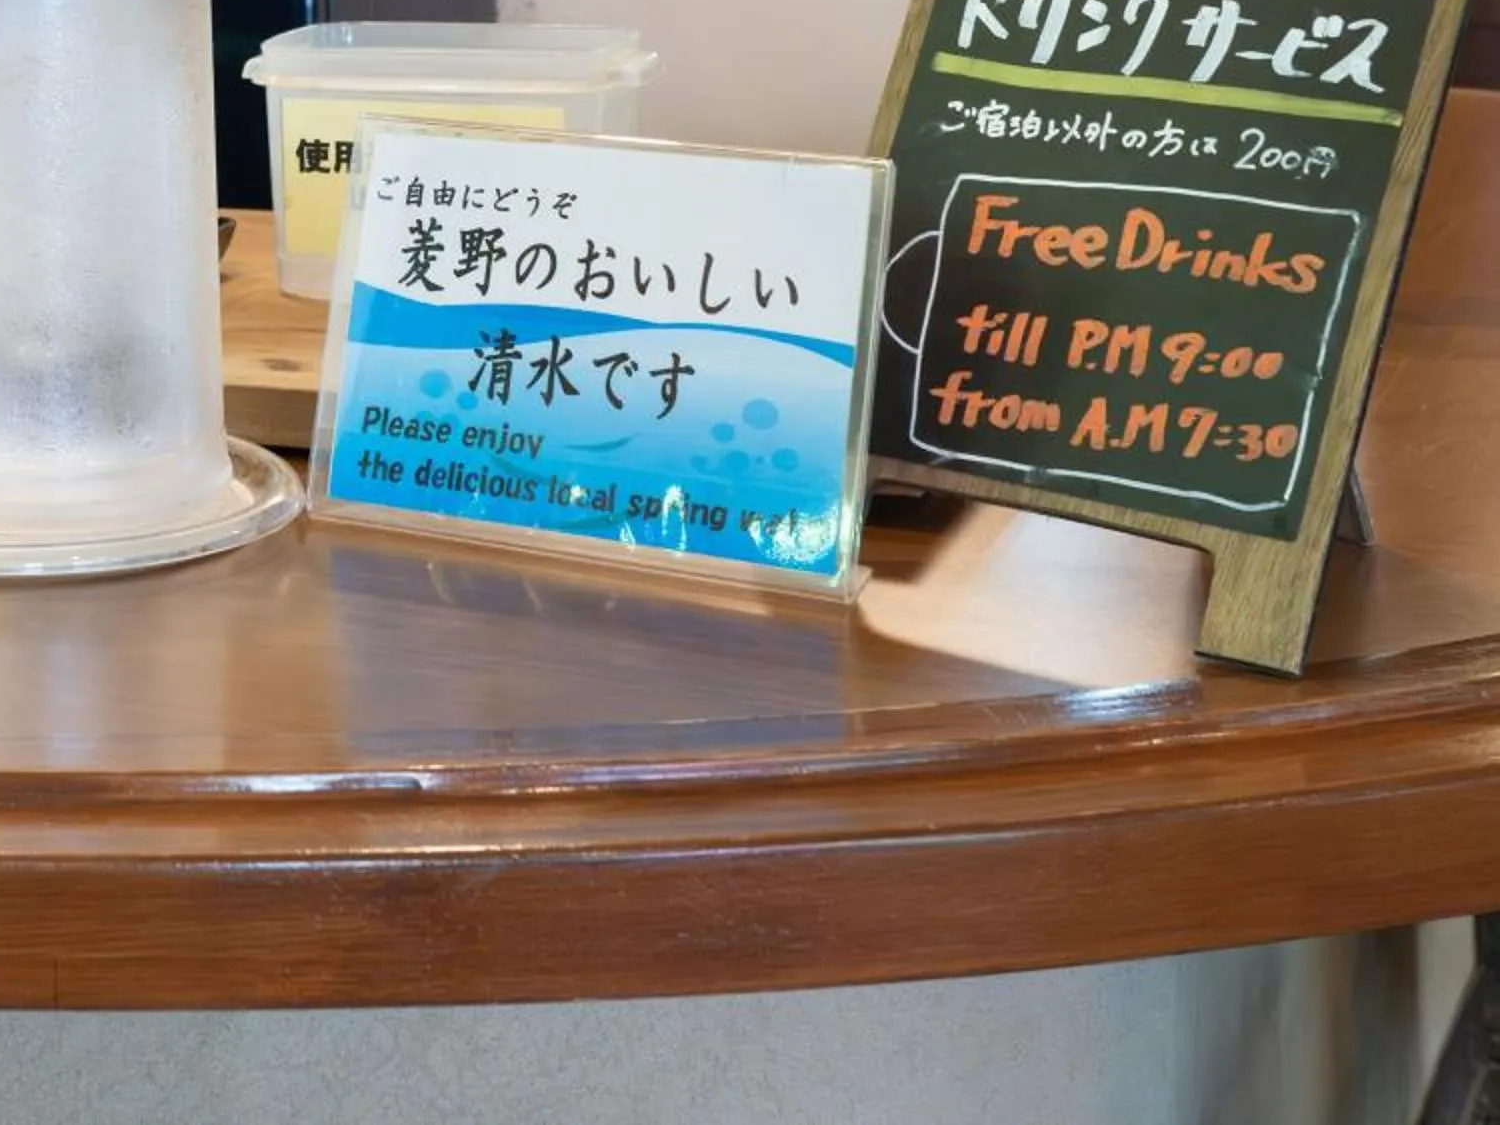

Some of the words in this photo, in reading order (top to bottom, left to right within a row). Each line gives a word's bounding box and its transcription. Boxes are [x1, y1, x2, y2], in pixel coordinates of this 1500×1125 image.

[940, 98, 1218, 157] ご宿泊以外の方は
[377, 176, 578, 220] ご自由にどうぞ
[398, 216, 800, 315] 菱野のおいしい
[966, 195, 1110, 270] Free
[1115, 206, 1326, 294] Drinks
[466, 328, 697, 420] 清水です
[956, 303, 1048, 367] till
[1160, 331, 1285, 385] 9:00
[361, 406, 452, 443] Please
[461, 421, 546, 460] enjoy
[930, 370, 1061, 432] from
[1177, 405, 1300, 462] 7:30
[357, 450, 404, 484] the
[413, 458, 538, 502] delicious
[627, 491, 728, 532] sping
